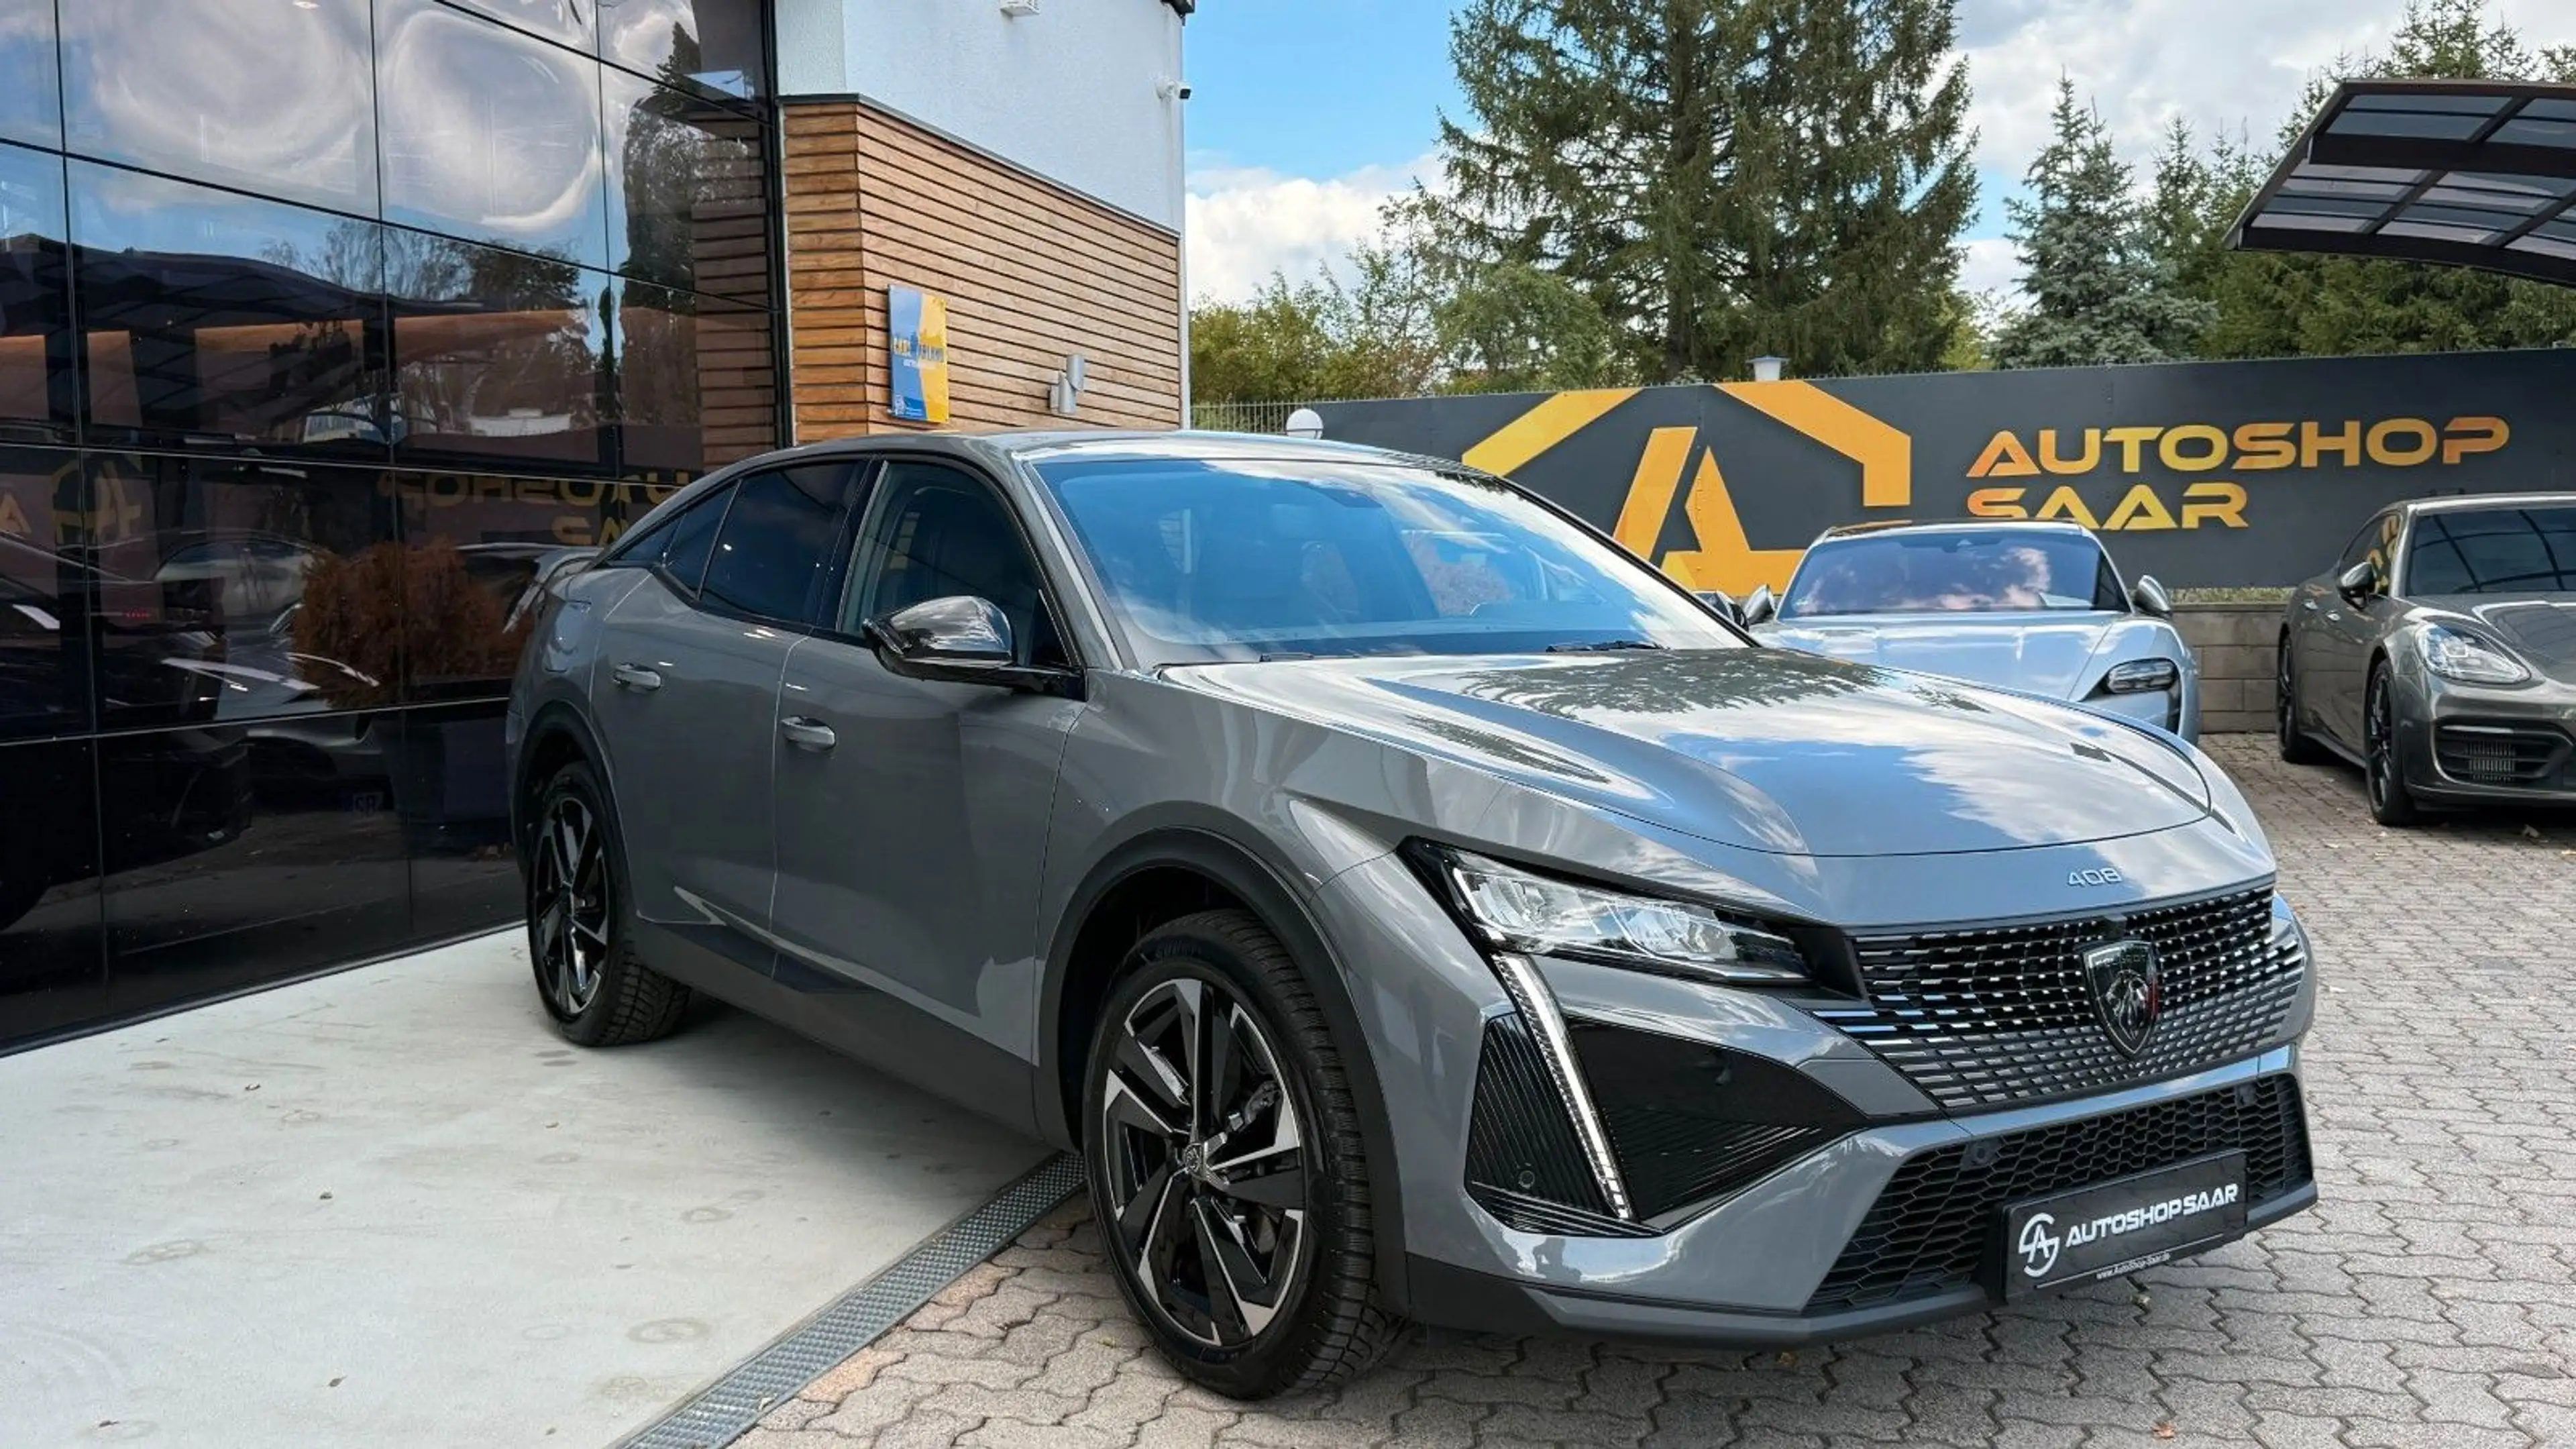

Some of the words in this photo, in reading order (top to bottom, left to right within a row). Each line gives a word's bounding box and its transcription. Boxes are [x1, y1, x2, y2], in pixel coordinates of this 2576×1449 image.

[1966, 416, 2510, 478] AUTOSHOP
[1966, 482, 2249, 530] SAAR
[2067, 867, 2123, 888] 408
[2065, 1183, 2239, 1248] AUTOSHOPSAAR
